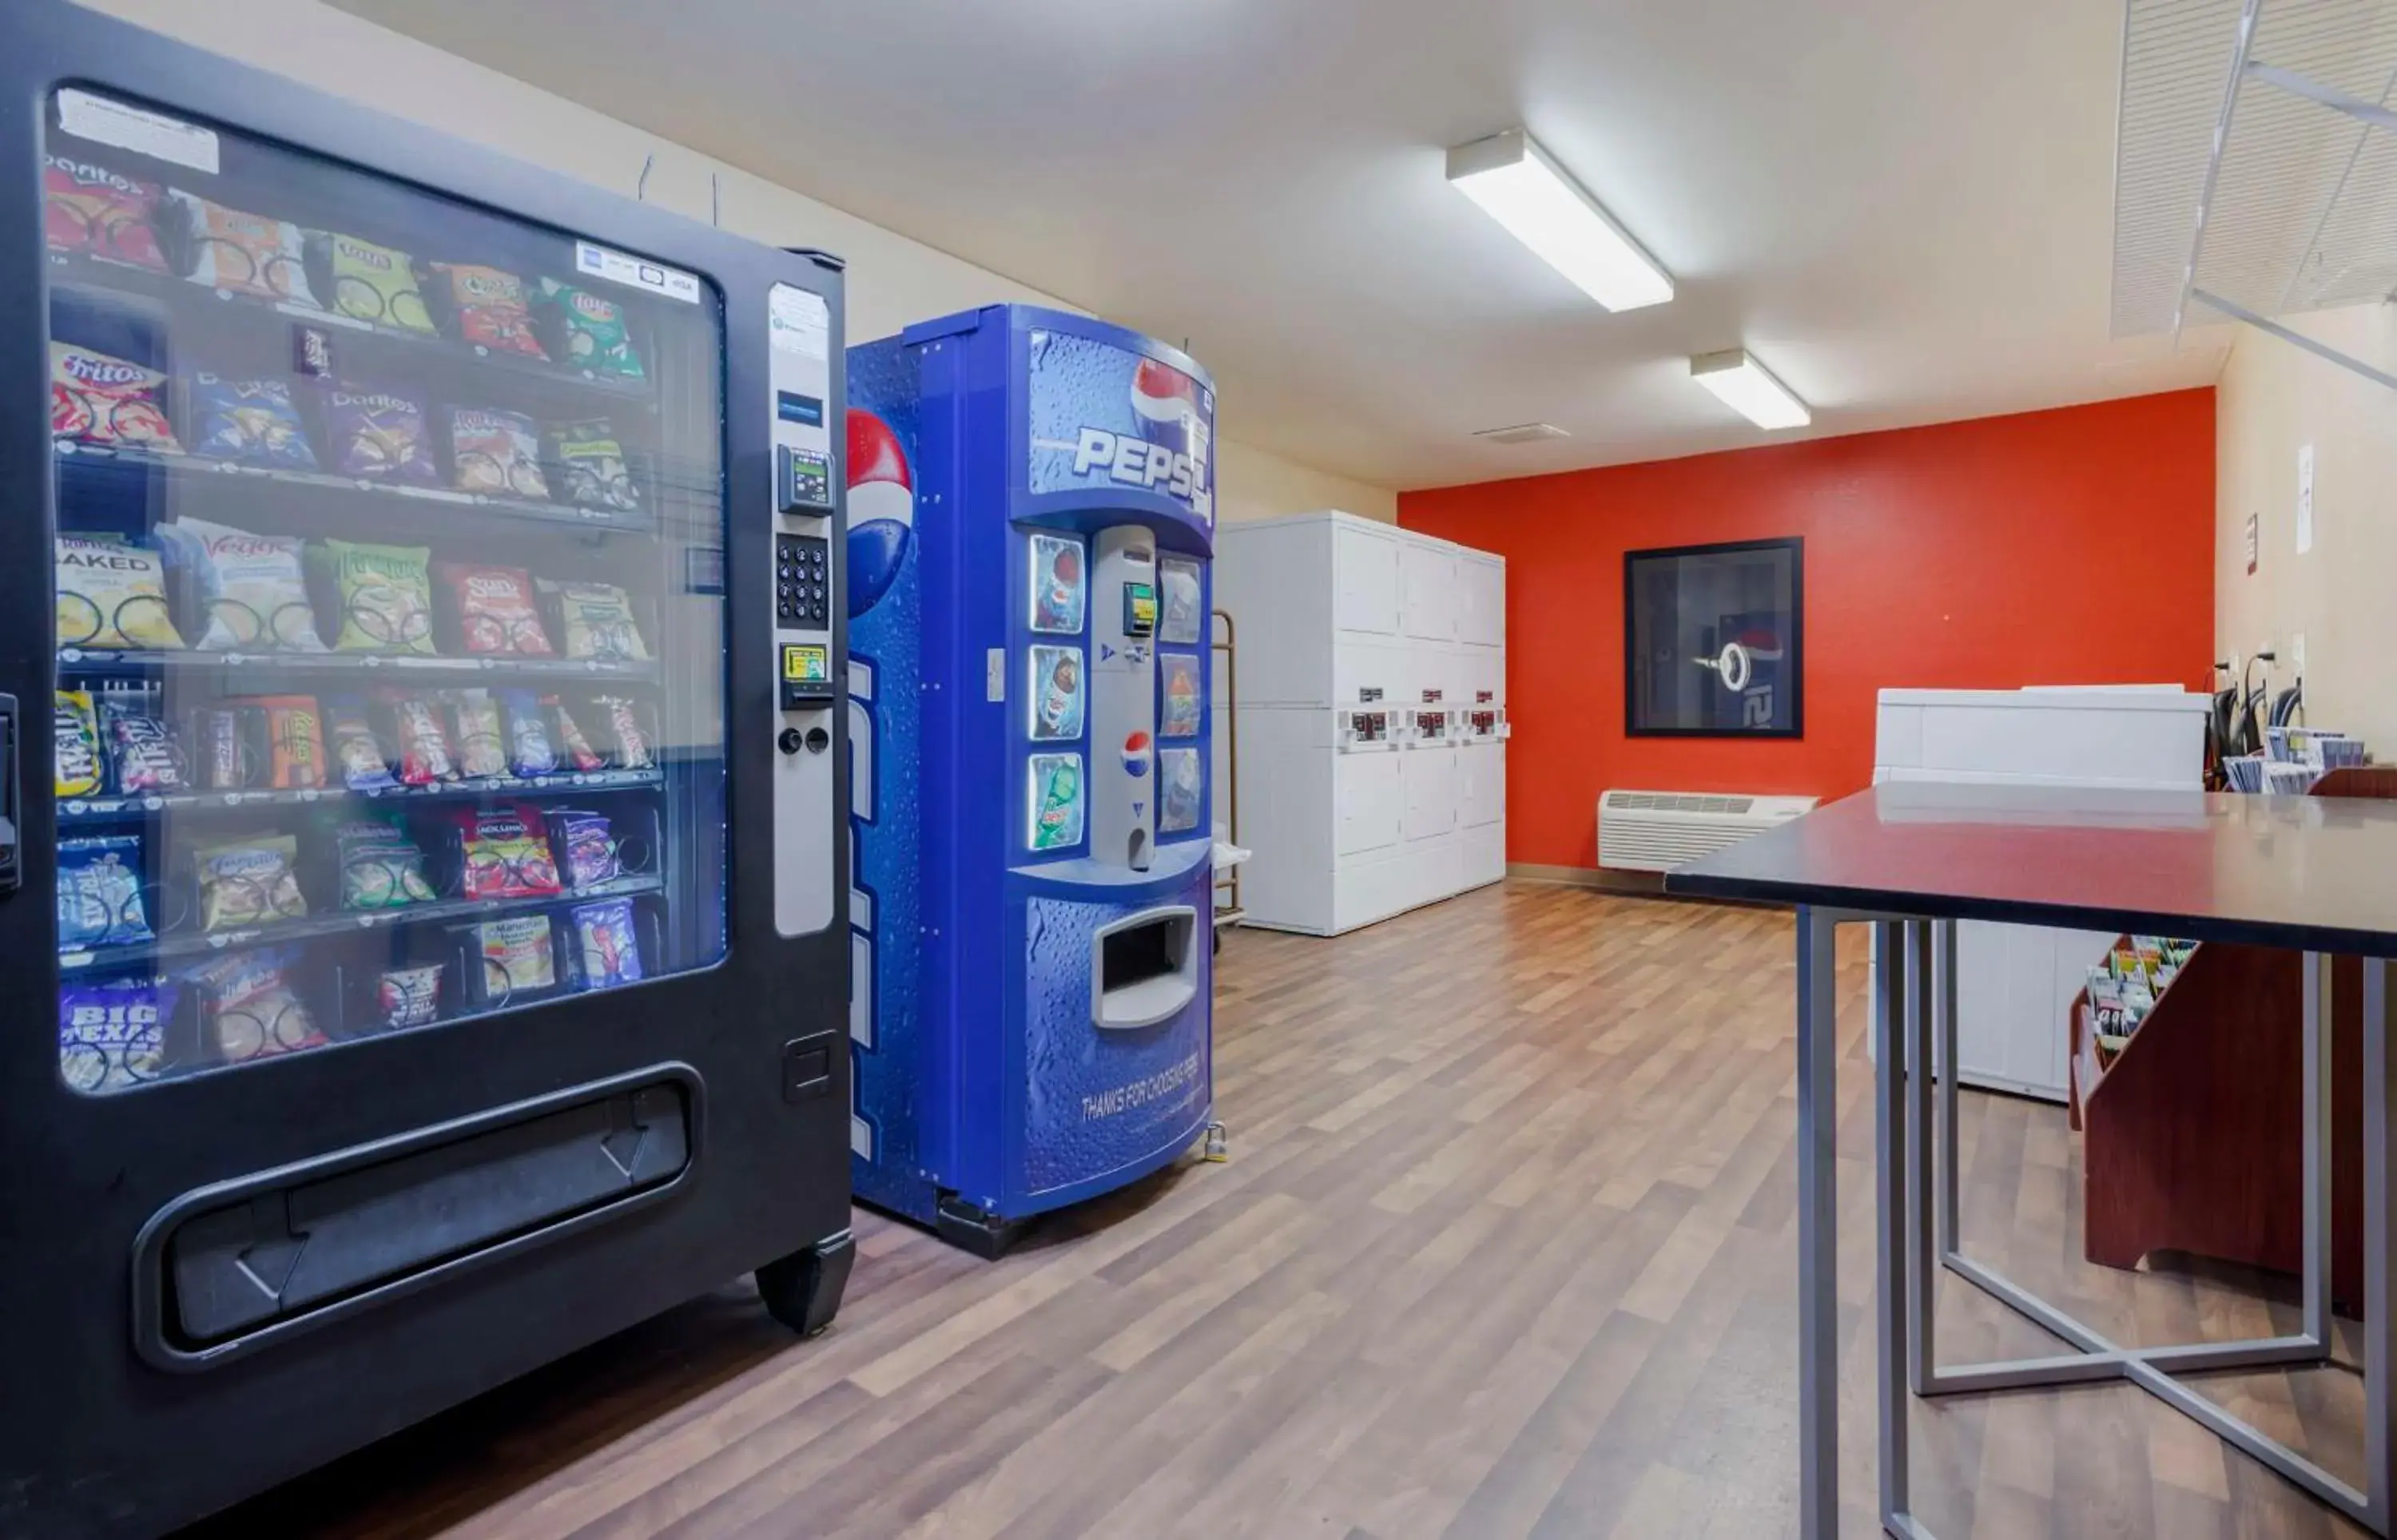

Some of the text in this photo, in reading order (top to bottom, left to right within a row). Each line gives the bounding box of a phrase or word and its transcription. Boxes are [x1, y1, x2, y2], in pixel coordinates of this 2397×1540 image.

[54, 554, 151, 571] AKED
[73, 1006, 157, 1026] BIG
[1082, 1088, 1124, 1124] THANKS
